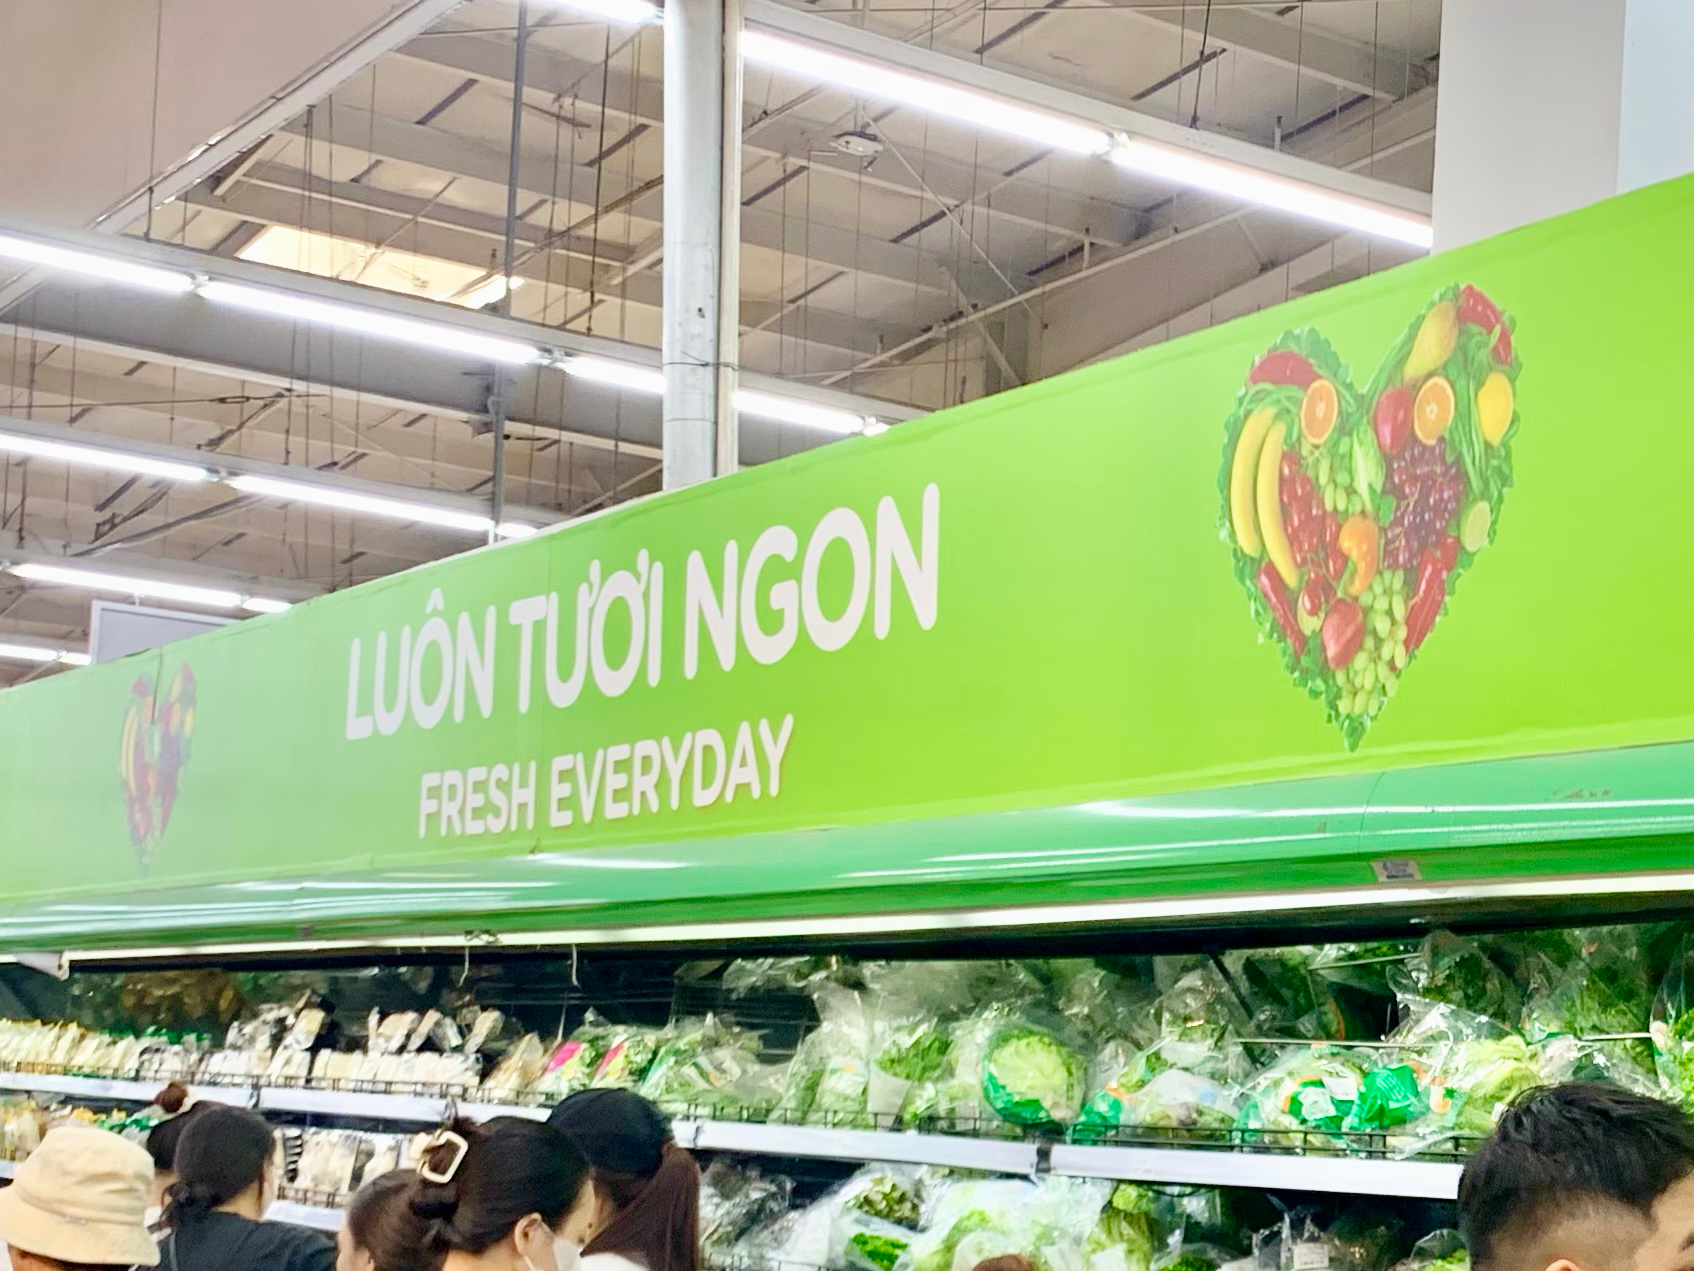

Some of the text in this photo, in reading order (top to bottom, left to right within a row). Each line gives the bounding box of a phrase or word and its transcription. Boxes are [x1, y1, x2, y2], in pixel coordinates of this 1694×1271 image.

[346, 482, 941, 741] LUÔN TƯƠI NGON
[419, 713, 795, 839] FRESH EVERYDAY
